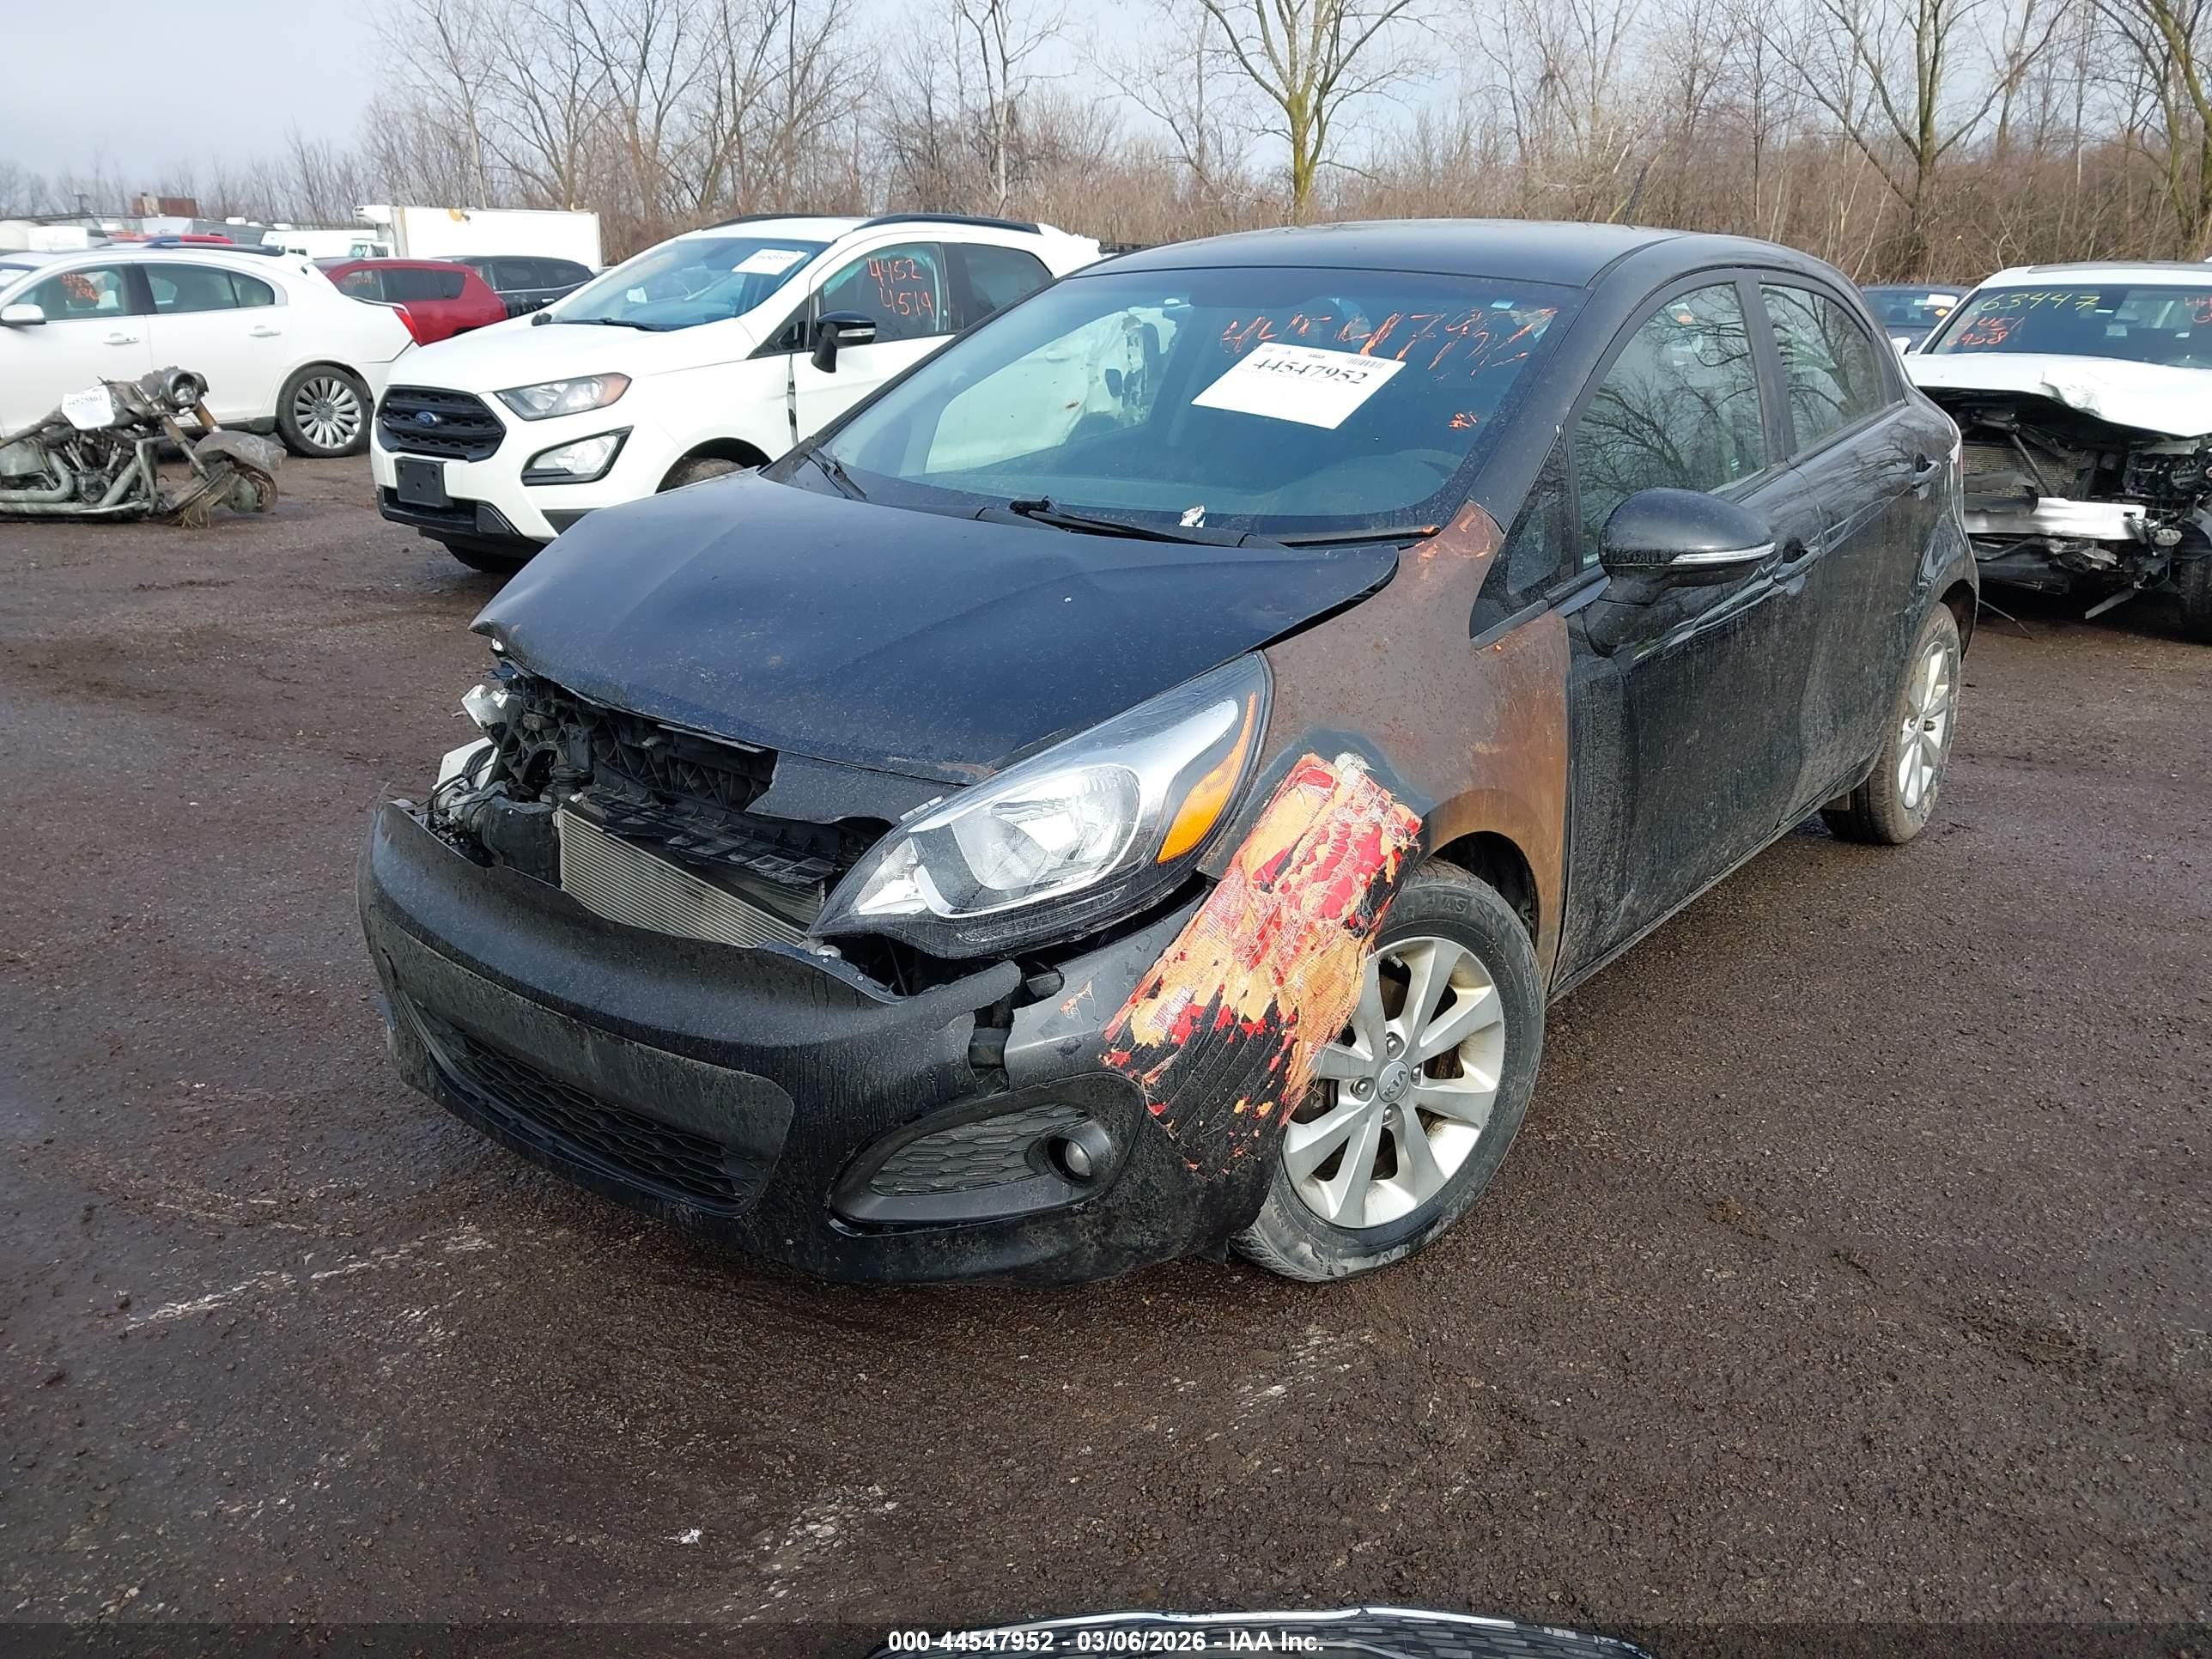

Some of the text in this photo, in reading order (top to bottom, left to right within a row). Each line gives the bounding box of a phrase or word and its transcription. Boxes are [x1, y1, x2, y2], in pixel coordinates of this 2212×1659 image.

[1981, 292, 2101, 312] 63447
[1253, 357, 1369, 385] 44547952
[1381, 1069, 1407, 1098] KIA
